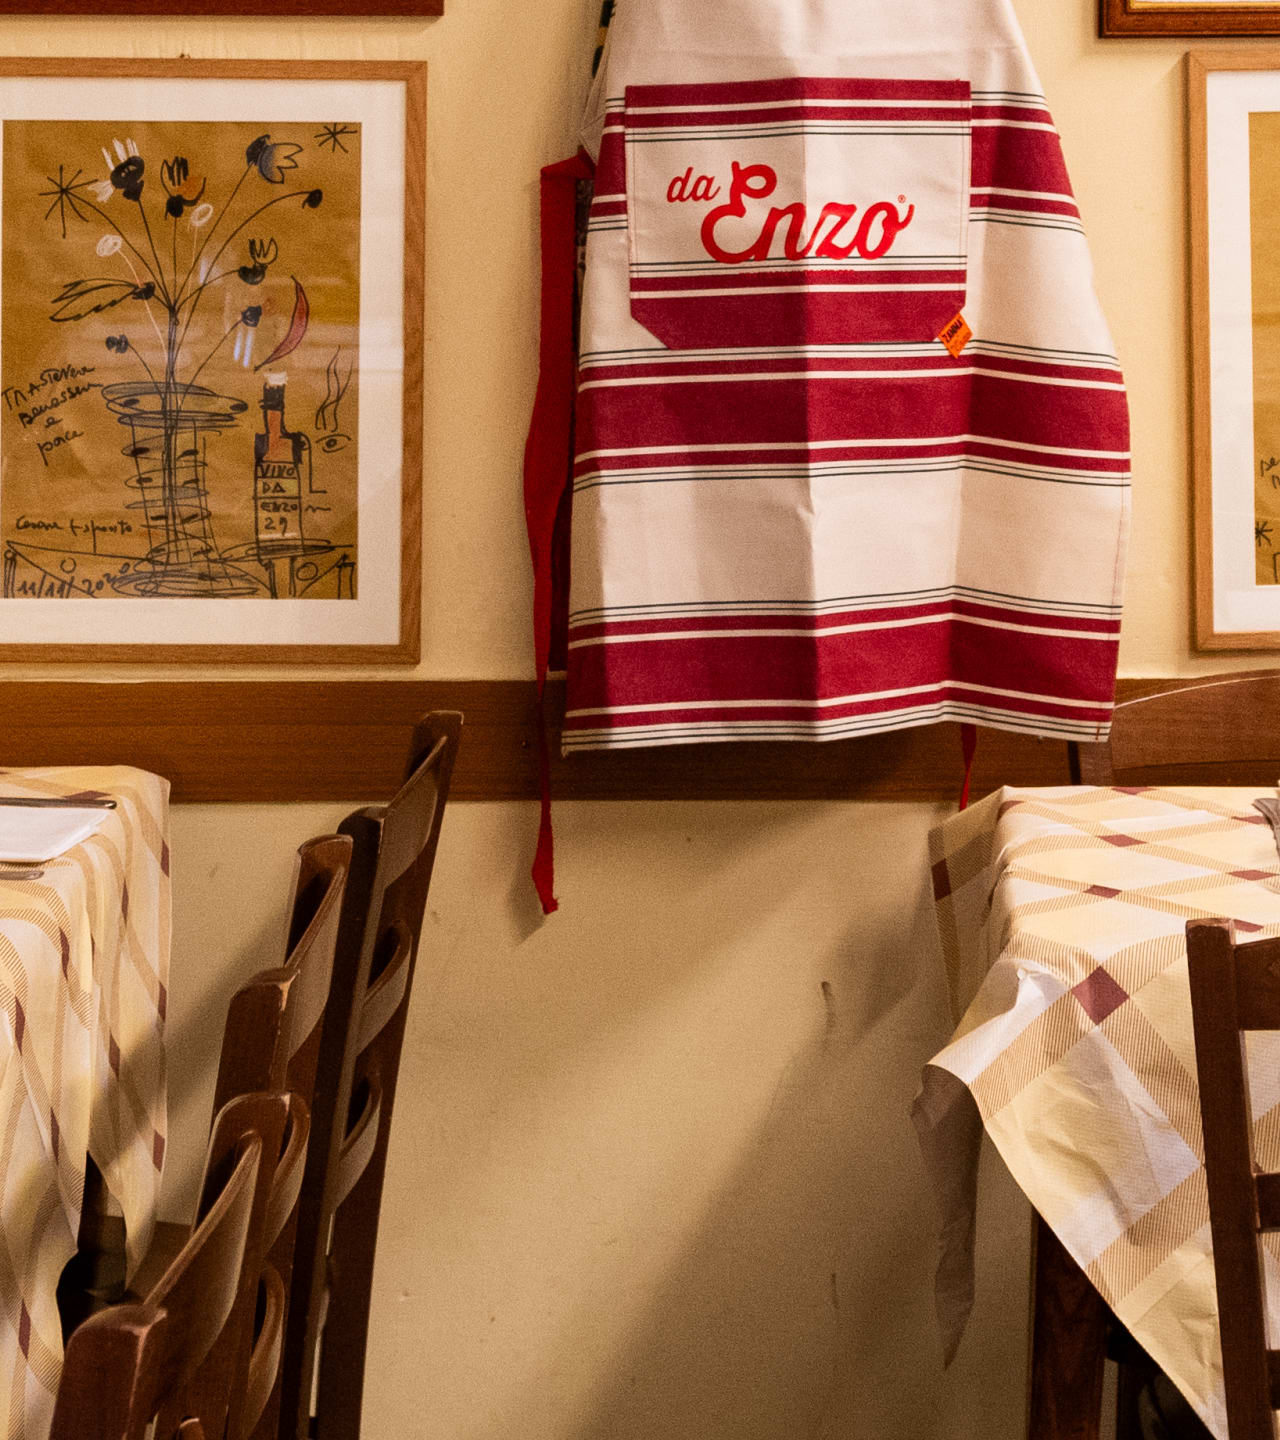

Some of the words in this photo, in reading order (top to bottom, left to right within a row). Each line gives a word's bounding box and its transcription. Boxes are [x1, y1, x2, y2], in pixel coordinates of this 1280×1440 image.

[666, 166, 721, 203] da
[701, 161, 915, 264] Enzo
[260, 463, 296, 477] VINO
